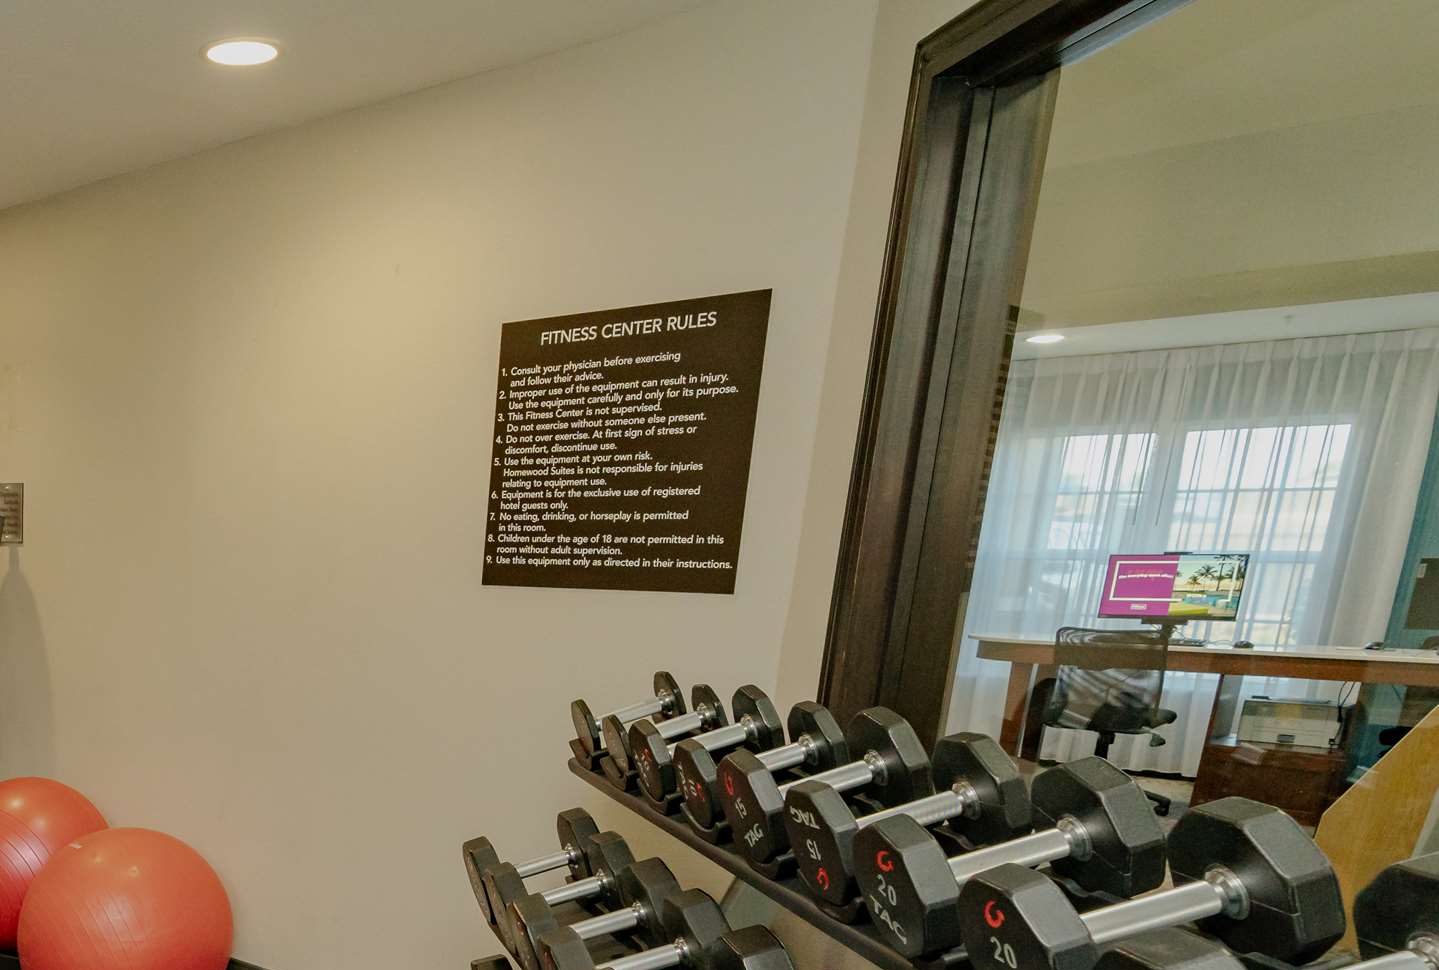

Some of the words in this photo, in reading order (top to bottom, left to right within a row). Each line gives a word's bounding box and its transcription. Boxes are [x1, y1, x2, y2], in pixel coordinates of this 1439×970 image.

[540, 325, 598, 346] FITNESS
[601, 318, 662, 339] CENTER
[666, 312, 717, 331] RULES
[502, 368, 508, 377] 1.
[510, 365, 542, 376] Consult
[542, 364, 562, 375] your
[562, 359, 602, 373] physician
[603, 356, 633, 367] before
[635, 352, 681, 364] exercising
[498, 390, 507, 399] 2.
[509, 389, 547, 400] Improper
[564, 384, 575, 394] of
[575, 384, 590, 393] the
[591, 380, 640, 393] equipment
[660, 375, 687, 386] result
[688, 374, 698, 384] in
[700, 372, 729, 384] injury.
[510, 377, 526, 387] and
[527, 376, 552, 386] follow
[553, 373, 573, 383] their
[574, 371, 604, 381] advice.
[508, 401, 524, 410] Use
[525, 399, 539, 409] the
[540, 396, 586, 409] equipment
[587, 392, 624, 404] carefully
[625, 391, 643, 401] and
[644, 389, 665, 401] only
[666, 388, 681, 398] for
[682, 387, 694, 397] its
[695, 386, 739, 398] purpose.
[497, 413, 505, 422] 3.
[509, 412, 524, 421] This
[525, 411, 554, 420] Fitness
[555, 408, 584, 418] Center
[586, 407, 593, 416] is
[594, 406, 610, 415] not
[611, 402, 663, 416] supervised.
[506, 423, 519, 433] Do
[520, 423, 534, 432] not
[535, 420, 569, 431] exercise
[570, 418, 603, 428] without
[604, 417, 646, 426] someone
[647, 414, 666, 424] else
[668, 412, 707, 425] present.
[495, 435, 503, 444] 4.
[505, 434, 518, 444] Do
[519, 435, 533, 443] not
[554, 431, 590, 441] exercise.
[592, 430, 603, 439] At
[604, 429, 622, 438] first
[624, 428, 643, 439] sign
[644, 426, 656, 436] of
[657, 427, 684, 435] stress
[504, 444, 549, 455] discomfort,
[550, 442, 598, 452] discontinue
[494, 458, 502, 466] 5.
[504, 457, 520, 466] Use
[520, 456, 534, 465] the
[535, 455, 580, 466] equipment
[581, 454, 591, 462] at
[592, 455, 612, 464] your
[634, 451, 653, 461] risk.
[503, 466, 549, 477] Homewood
[550, 466, 575, 475] Suites
[576, 465, 584, 474] is
[585, 466, 601, 474] not
[602, 463, 653, 476] responsible
[654, 462, 669, 472] for
[670, 461, 704, 473] injuries
[502, 478, 532, 490] relating
[533, 479, 542, 487] to
[543, 477, 588, 489] equipment
[491, 490, 499, 499] 6.
[501, 490, 544, 501] Equipment
[545, 489, 552, 498] is
[554, 489, 566, 498] for
[567, 488, 582, 498] the
[583, 488, 622, 497] exclusive
[641, 487, 652, 496] of
[652, 486, 701, 498] registered
[500, 501, 521, 510] hotel
[521, 502, 548, 512] guests
[549, 500, 569, 511] only.
[490, 512, 496, 521] 7.
[499, 512, 512, 521] No
[513, 512, 540, 523] eating,
[541, 511, 577, 523] drinking,
[590, 511, 632, 522] horseplay
[633, 511, 641, 520] is
[642, 510, 689, 522] permitted
[498, 523, 506, 532] in
[507, 523, 522, 532] this
[487, 534, 495, 543] 8.
[497, 534, 530, 543] Children
[531, 534, 556, 543] under
[557, 534, 571, 543] the
[572, 536, 589, 545] age
[590, 534, 600, 543] of
[602, 534, 612, 543] 18
[630, 535, 646, 543] not
[647, 534, 694, 546] permitted
[695, 535, 705, 544] in
[707, 535, 724, 544] this
[518, 545, 549, 554] without
[550, 545, 572, 554] adult
[573, 546, 623, 557] supervision.
[486, 555, 493, 564] 9.
[496, 555, 511, 564] Use
[512, 555, 526, 565] this
[527, 556, 571, 567] equipment
[572, 557, 591, 568] only
[603, 557, 641, 567] directed
[642, 558, 651, 567] in
[652, 558, 674, 568] their
[676, 558, 733, 569] instructions.
[734, 797, 748, 820] 15
[790, 806, 821, 830] TAG
[744, 823, 765, 848] TAG
[806, 838, 822, 861] 15
[876, 874, 897, 906] 20
[870, 894, 908, 945] TAG
[990, 936, 1018, 969] 20
